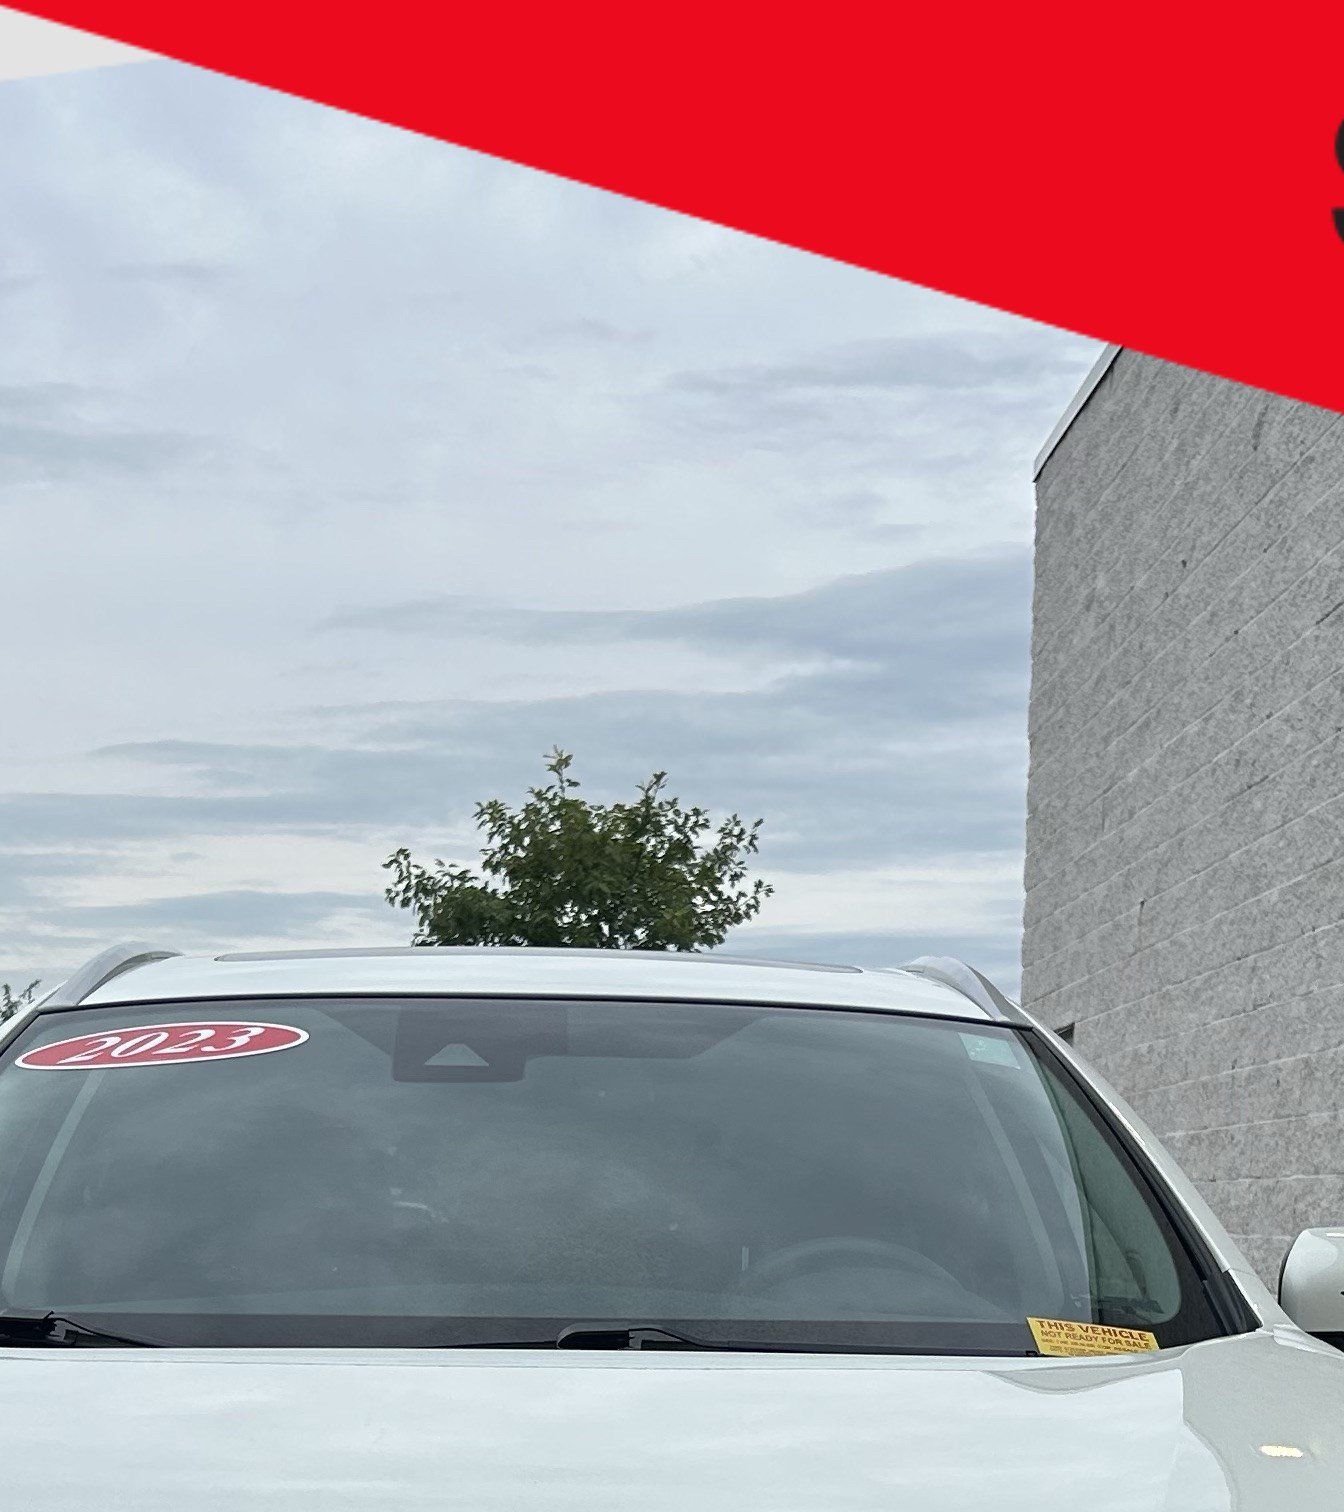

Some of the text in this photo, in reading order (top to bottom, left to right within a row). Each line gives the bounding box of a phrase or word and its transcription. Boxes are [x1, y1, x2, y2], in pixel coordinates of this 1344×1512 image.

[57, 1026, 265, 1065] 2023
[1037, 1319, 1150, 1342] THIS VEHICLE
[1040, 1329, 1062, 1338] NOT
[1065, 1332, 1099, 1343] READY
[1101, 1336, 1123, 1345] FOR
[1123, 1340, 1151, 1350] SALE
